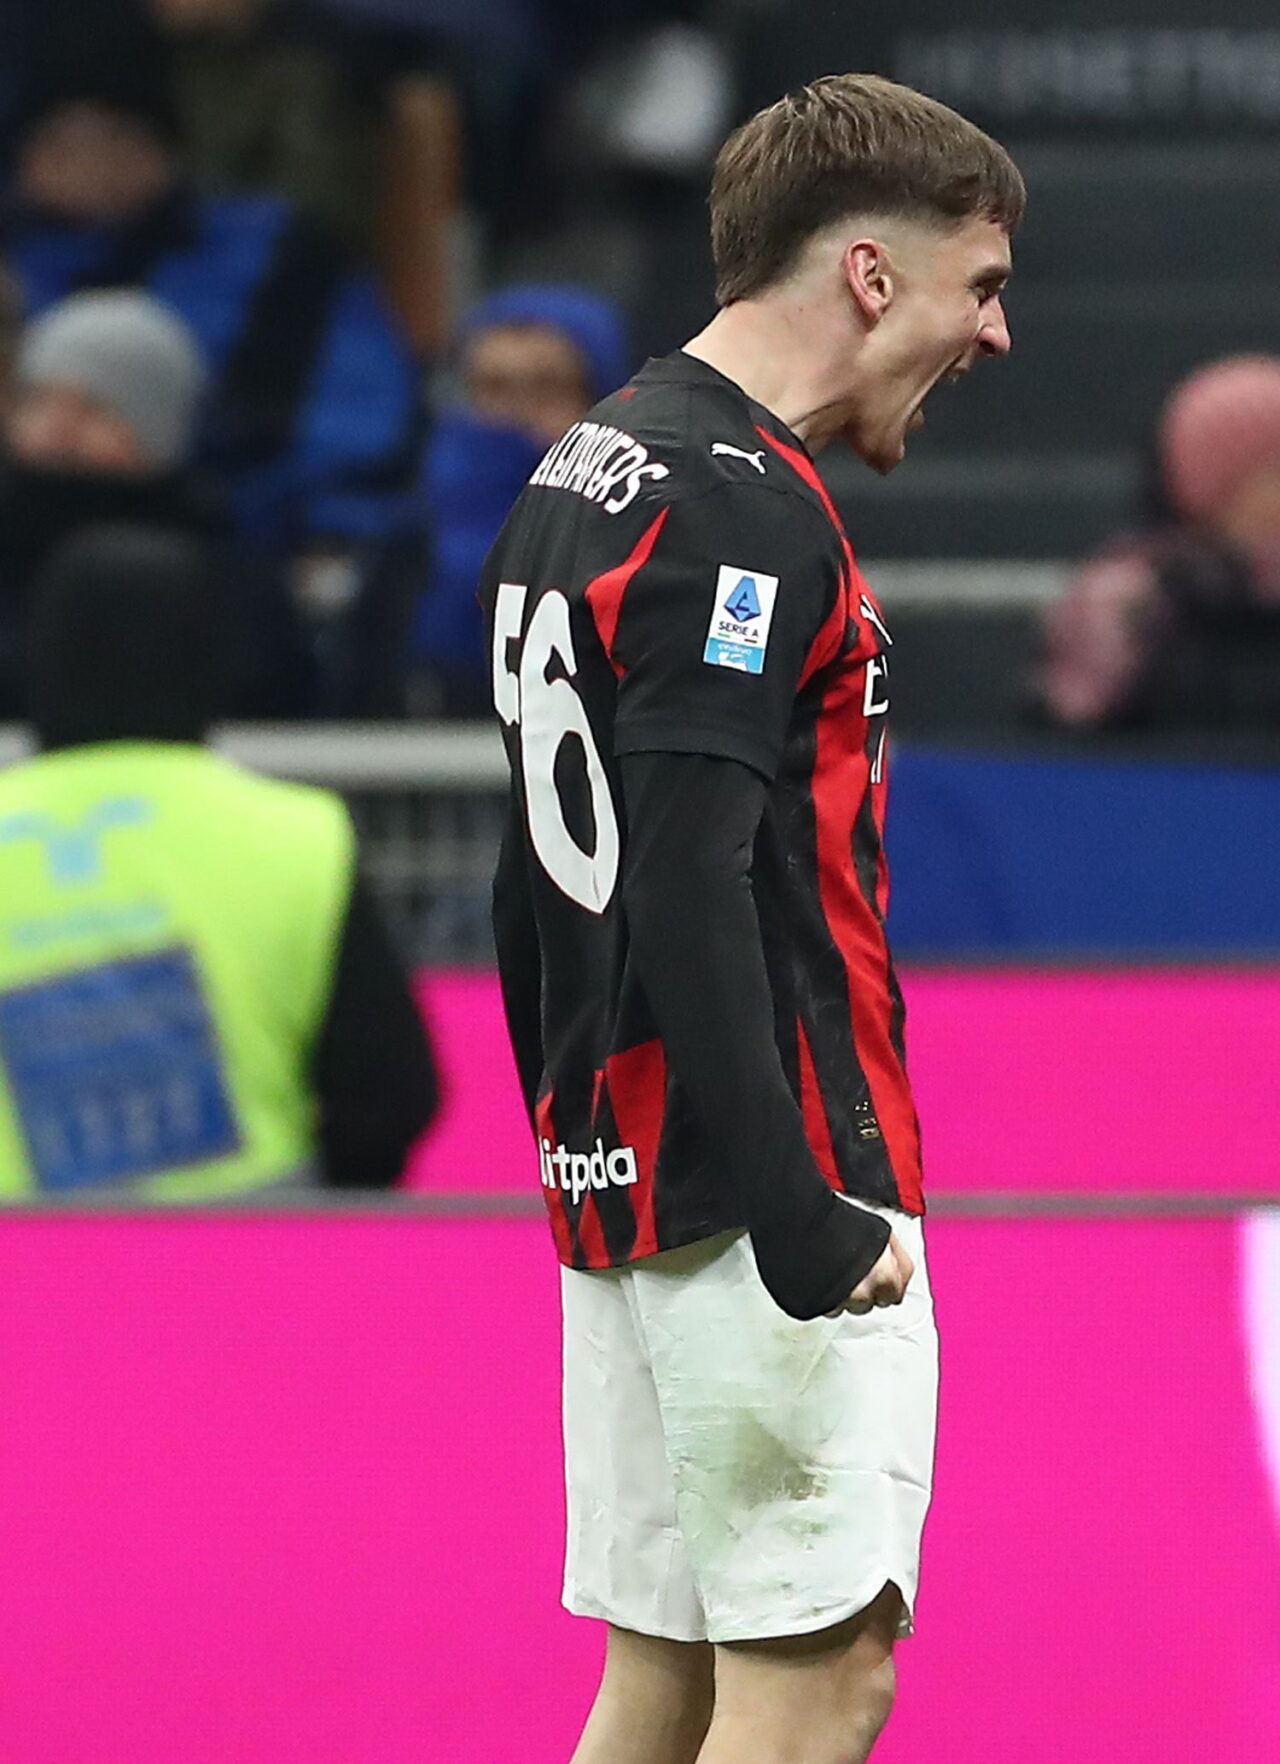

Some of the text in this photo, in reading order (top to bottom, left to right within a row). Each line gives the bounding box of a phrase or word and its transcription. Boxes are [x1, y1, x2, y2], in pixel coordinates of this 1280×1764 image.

[718, 621, 760, 638] SERIE A
[493, 583, 620, 914] 56
